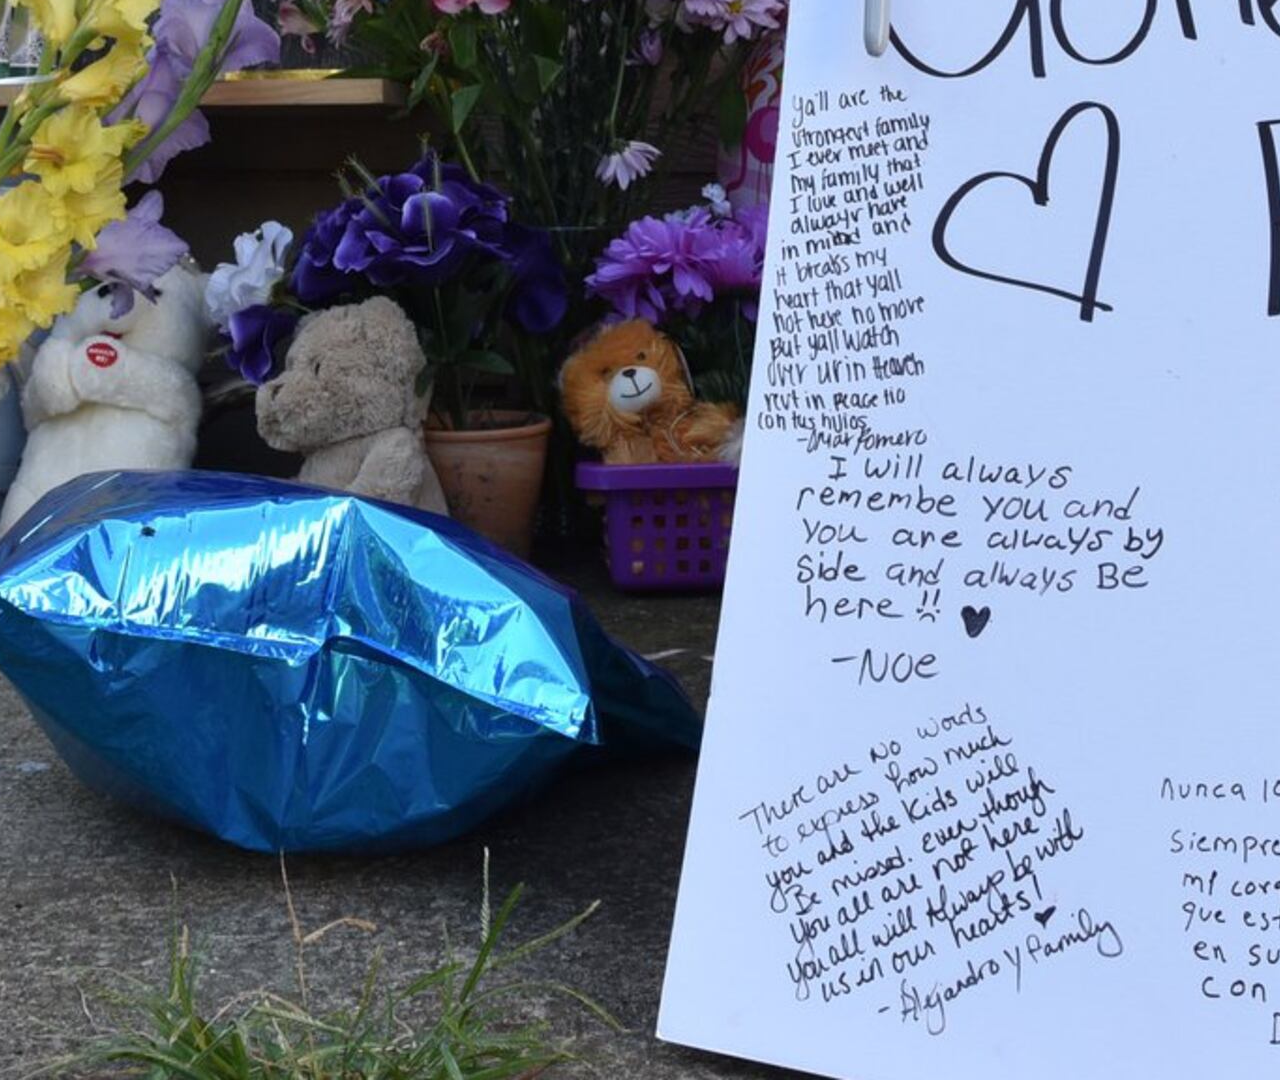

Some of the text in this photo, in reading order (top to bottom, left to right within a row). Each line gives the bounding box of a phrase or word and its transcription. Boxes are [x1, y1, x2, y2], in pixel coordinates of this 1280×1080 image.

[838, 84, 908, 110] are the
[874, 111, 931, 143] family
[892, 124, 930, 153] and
[821, 162, 880, 191] family
[843, 183, 880, 204] and
[776, 286, 819, 309] heart
[864, 452, 1073, 490] will always
[796, 483, 1141, 521] remembe and
[891, 525, 1165, 561] are always by
[885, 557, 1149, 596] and always Be
[804, 583, 905, 624] here
[738, 702, 988, 835] There are words
[761, 724, 1014, 861] to express how much
[1160, 777, 1247, 802] nunca
[811, 752, 1020, 866] and the will
[785, 760, 1056, 915] Be though
[828, 807, 1085, 967] all will be with
[836, 815, 1041, 927] all are not here
[1181, 900, 1227, 932] que
[855, 939, 937, 988] in our
[1192, 940, 1227, 964] en
[898, 957, 1001, 1037] Alejandro
